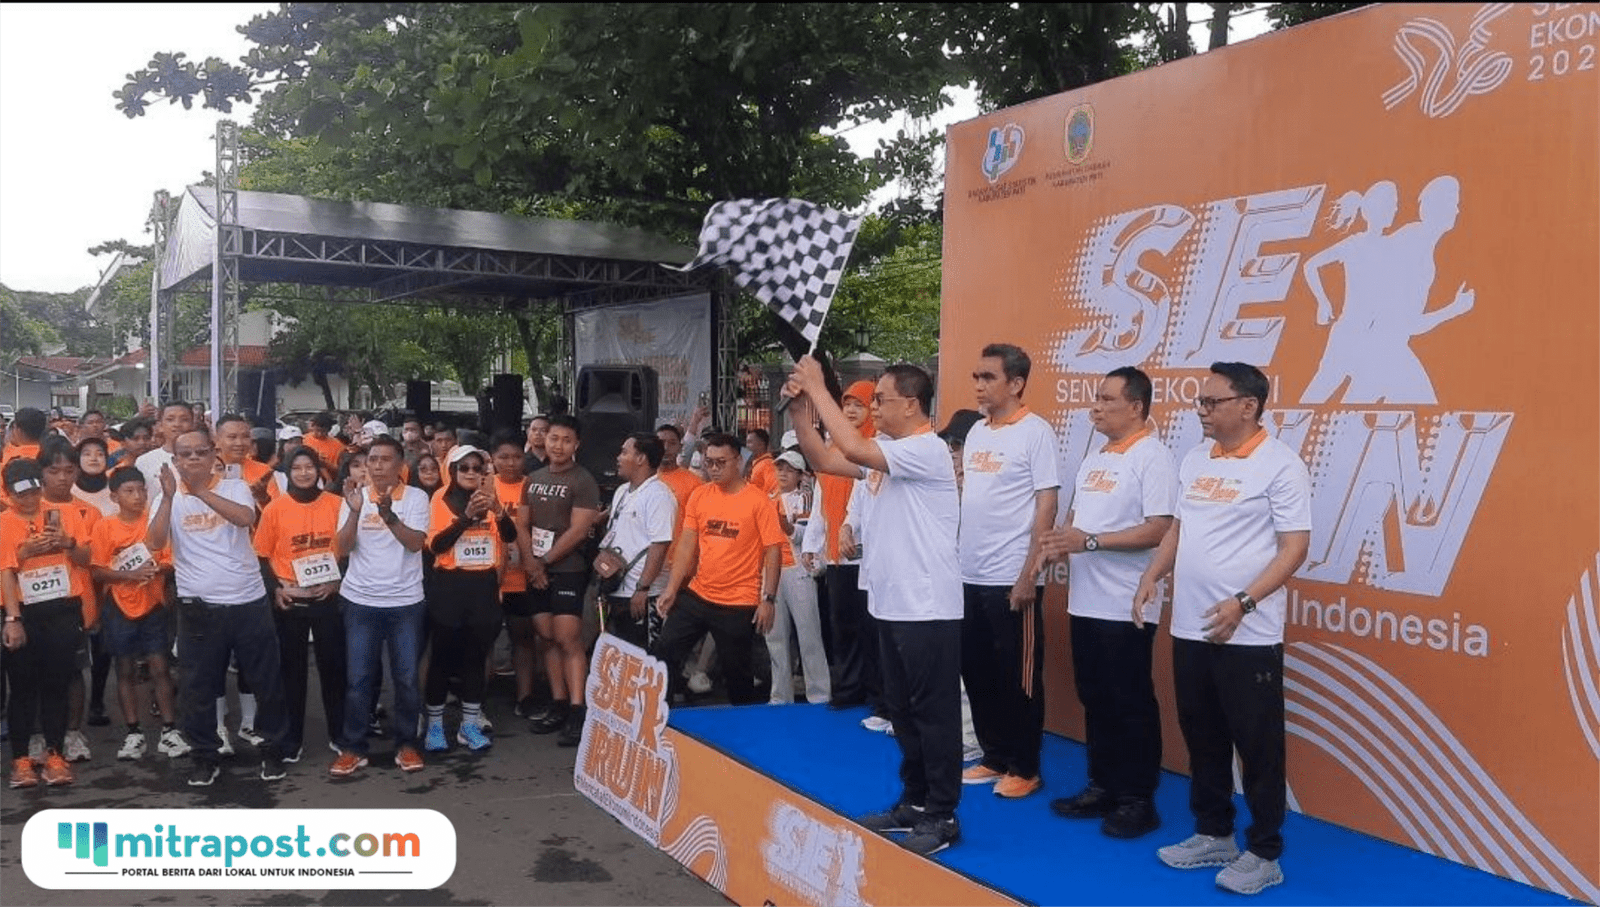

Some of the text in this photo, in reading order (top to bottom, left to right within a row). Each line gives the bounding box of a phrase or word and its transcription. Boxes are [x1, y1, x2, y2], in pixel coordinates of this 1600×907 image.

[464, 547, 487, 556] 0153
[304, 563, 331, 576] 0373
[31, 578, 61, 592] 0271
